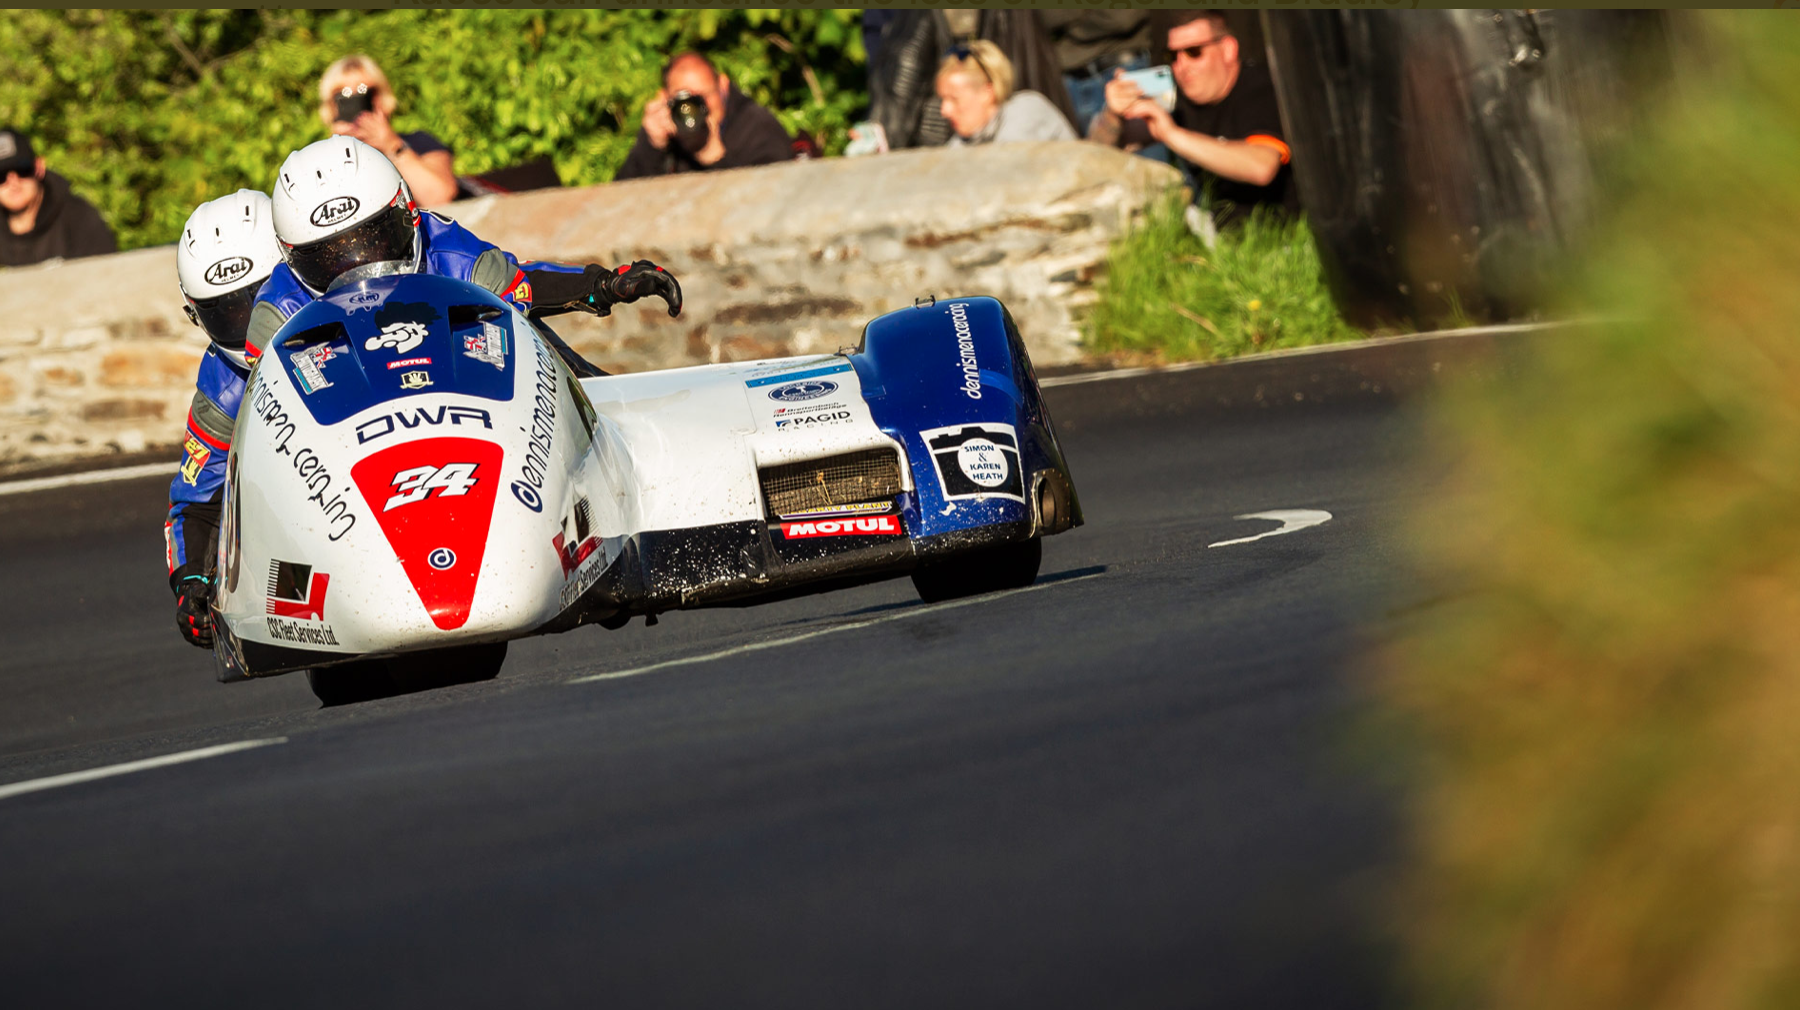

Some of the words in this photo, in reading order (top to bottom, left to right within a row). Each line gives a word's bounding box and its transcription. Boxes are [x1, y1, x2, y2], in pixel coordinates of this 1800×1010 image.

[316, 197, 354, 221] Arai
[208, 259, 247, 281] Arai
[945, 303, 982, 399] dennismenaceracing
[389, 358, 430, 369] MOTUL
[355, 405, 493, 445] DWR
[778, 419, 853, 432] RACING
[794, 411, 851, 425] PAGID
[964, 444, 995, 453] SIMON
[978, 452, 988, 463] &
[969, 463, 1001, 471] KAREN
[972, 472, 1003, 481] HEATH
[382, 462, 481, 513] 34
[789, 518, 895, 536] MOTUL
[266, 617, 283, 639] CSC
[278, 619, 297, 642] Fleet
[293, 621, 325, 645] Services
